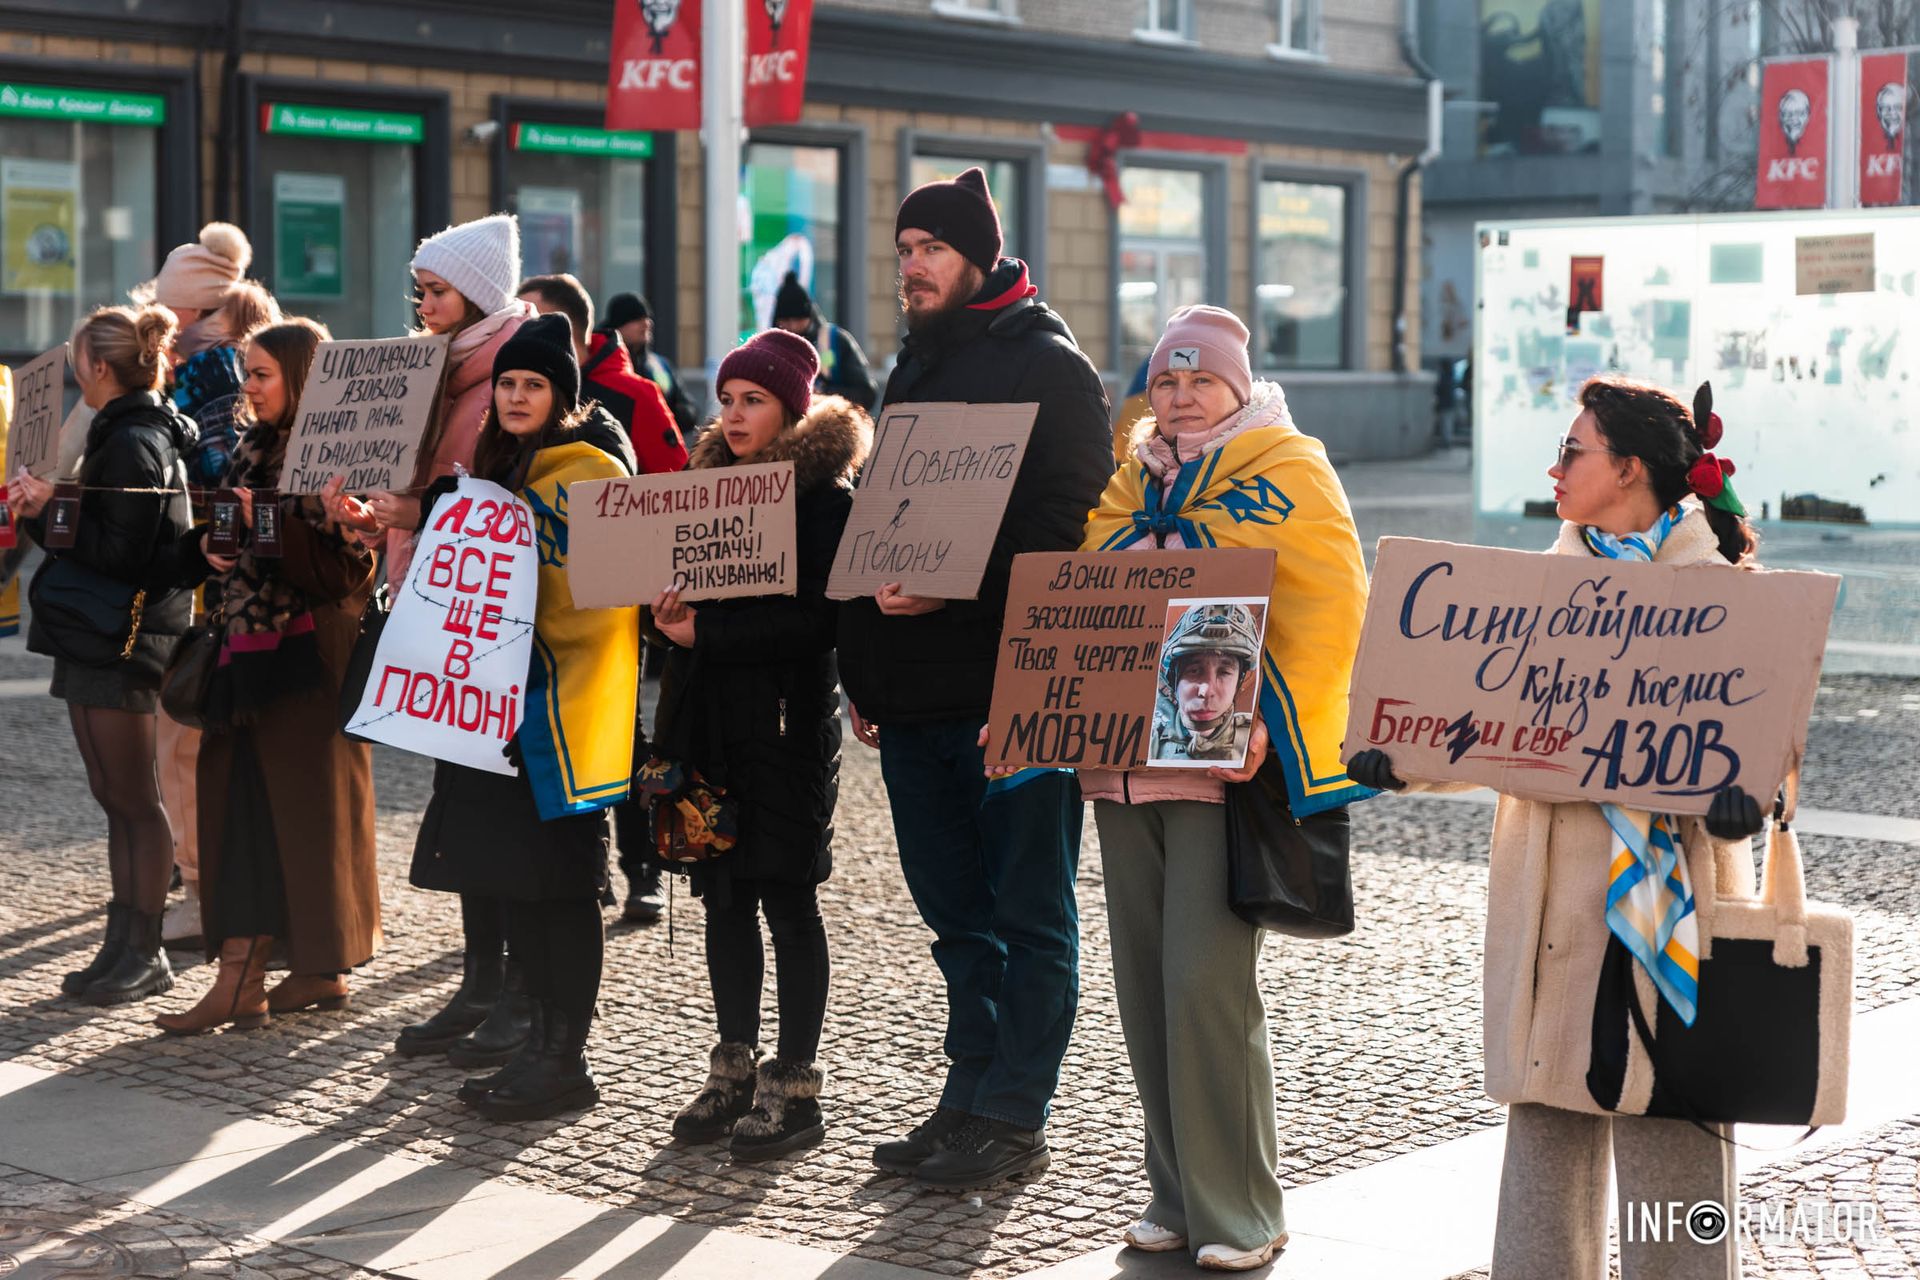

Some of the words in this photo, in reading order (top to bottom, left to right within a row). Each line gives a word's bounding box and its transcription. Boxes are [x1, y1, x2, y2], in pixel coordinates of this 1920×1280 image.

[618, 59, 695, 90] KFC
[749, 50, 797, 86] KFC
[1766, 157, 1819, 182] KFC
[1866, 152, 1902, 177] KF
[16, 361, 55, 427] FREE
[300, 409, 358, 437] ГНИЮТЬ
[11, 411, 53, 475] AZOV
[300, 442, 314, 470] У
[342, 466, 391, 493] ДУША
[714, 469, 793, 510] ПОЛОНУ
[432, 496, 533, 548] АЗОВ
[675, 506, 754, 543] БОЛЮ!
[672, 531, 762, 570] РОЗПАЧУ!
[427, 544, 516, 600] ВСЕ
[1124, 566, 1196, 590] тебе
[442, 596, 503, 641] ЩЕ
[443, 638, 474, 680] В
[1043, 675, 1085, 710] НЕ
[1511, 725, 1575, 756] себе
[1579, 718, 1742, 796] АЗОВ
